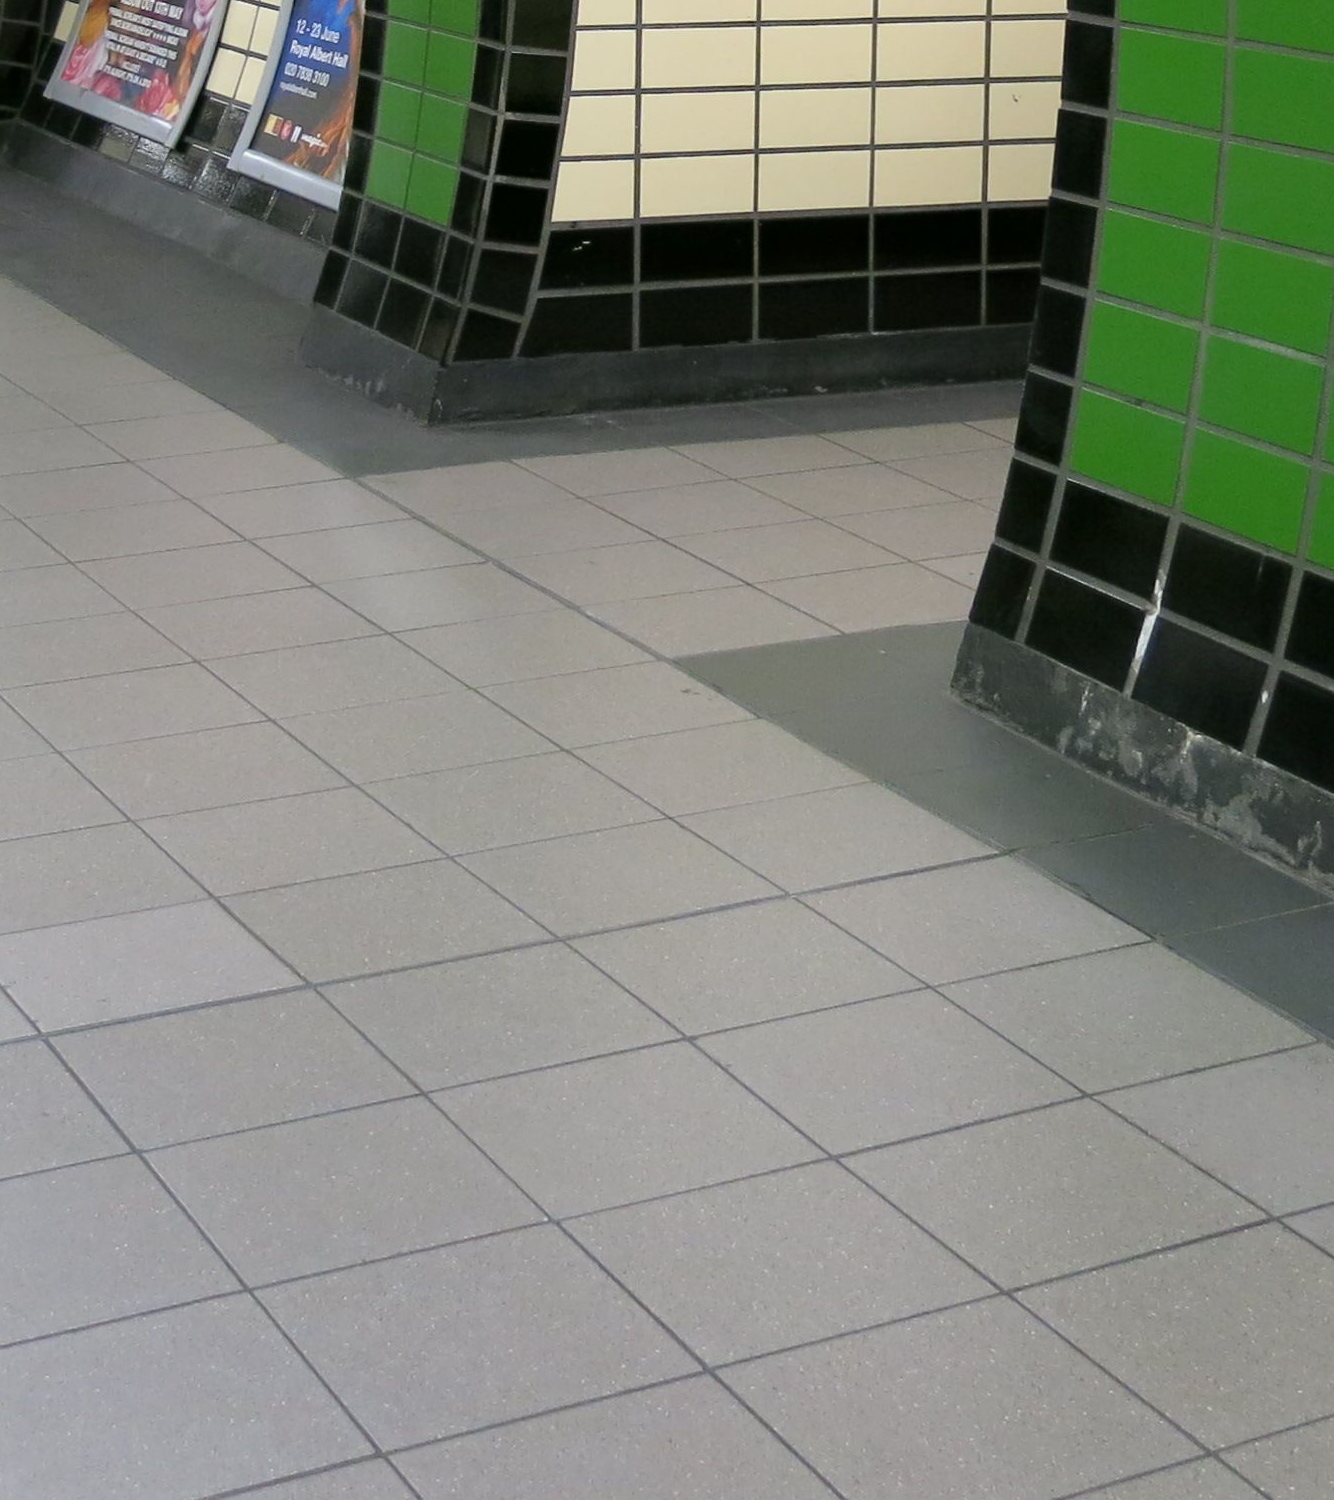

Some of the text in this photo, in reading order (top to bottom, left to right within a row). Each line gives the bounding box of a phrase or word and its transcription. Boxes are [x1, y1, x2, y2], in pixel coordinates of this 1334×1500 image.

[296, 19, 306, 34] 12
[311, 22, 323, 37] 23
[320, 26, 340, 43] June
[289, 40, 349, 69] Royal Albert Hall
